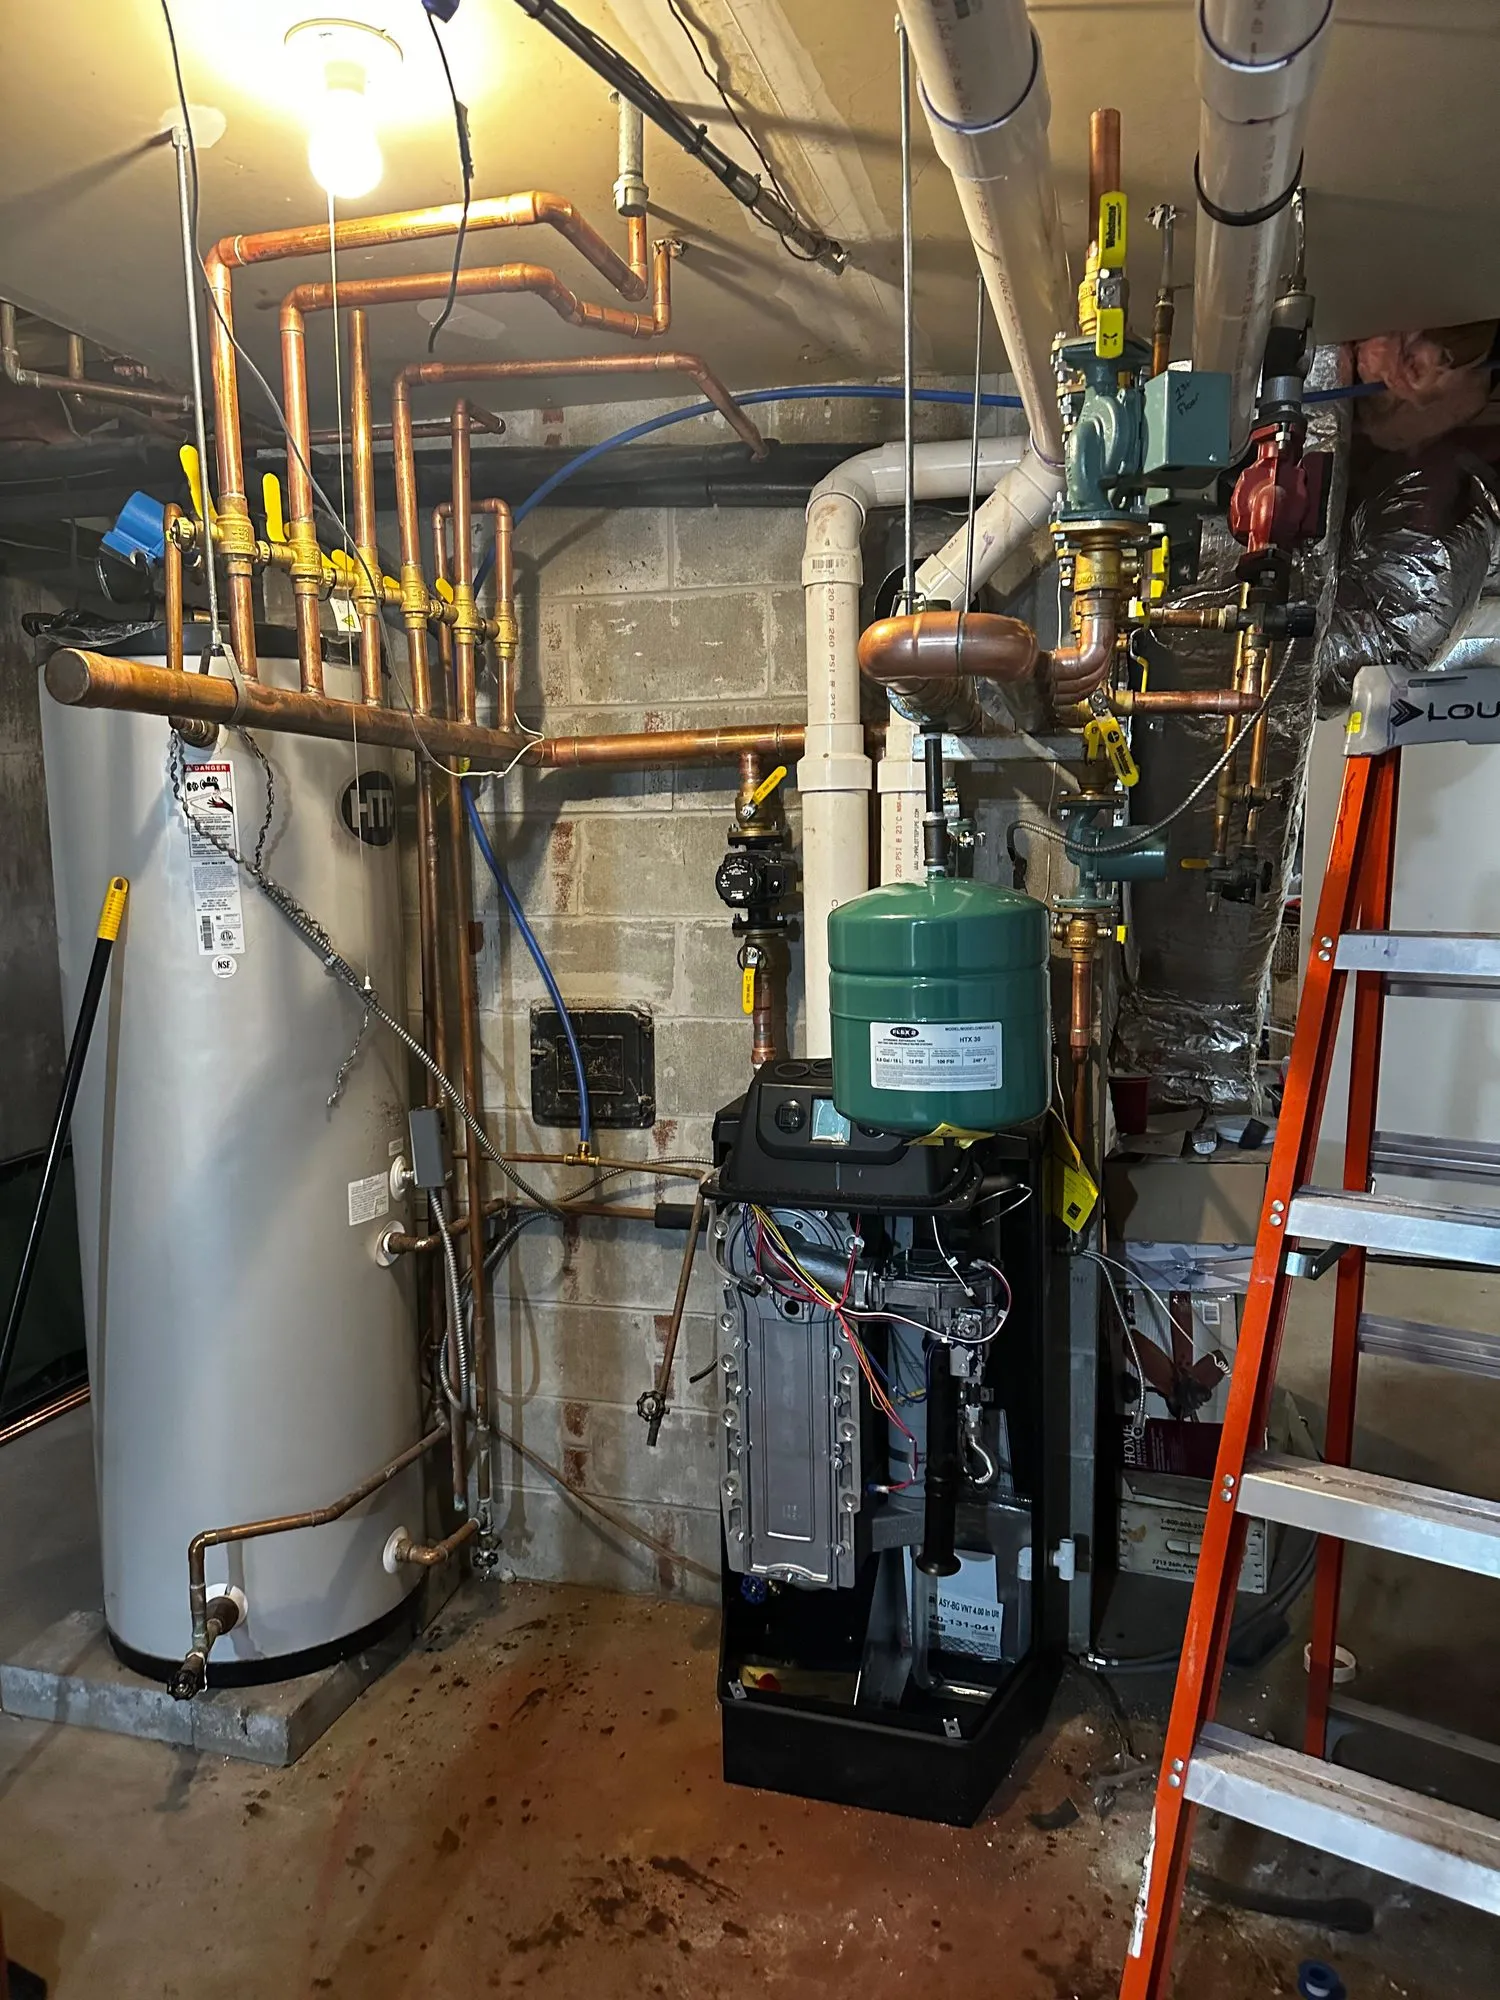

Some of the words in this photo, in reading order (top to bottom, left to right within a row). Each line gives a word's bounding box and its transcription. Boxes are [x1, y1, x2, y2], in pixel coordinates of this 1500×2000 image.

[829, 608, 835, 622] PR
[828, 628, 836, 648] 260
[217, 960, 231, 969] NSF
[1123, 1424, 1136, 1464] HOME
[939, 1597, 960, 1612] ASY-BG
[961, 1603, 973, 1615] VNT
[973, 1606, 985, 1617] 4.00
